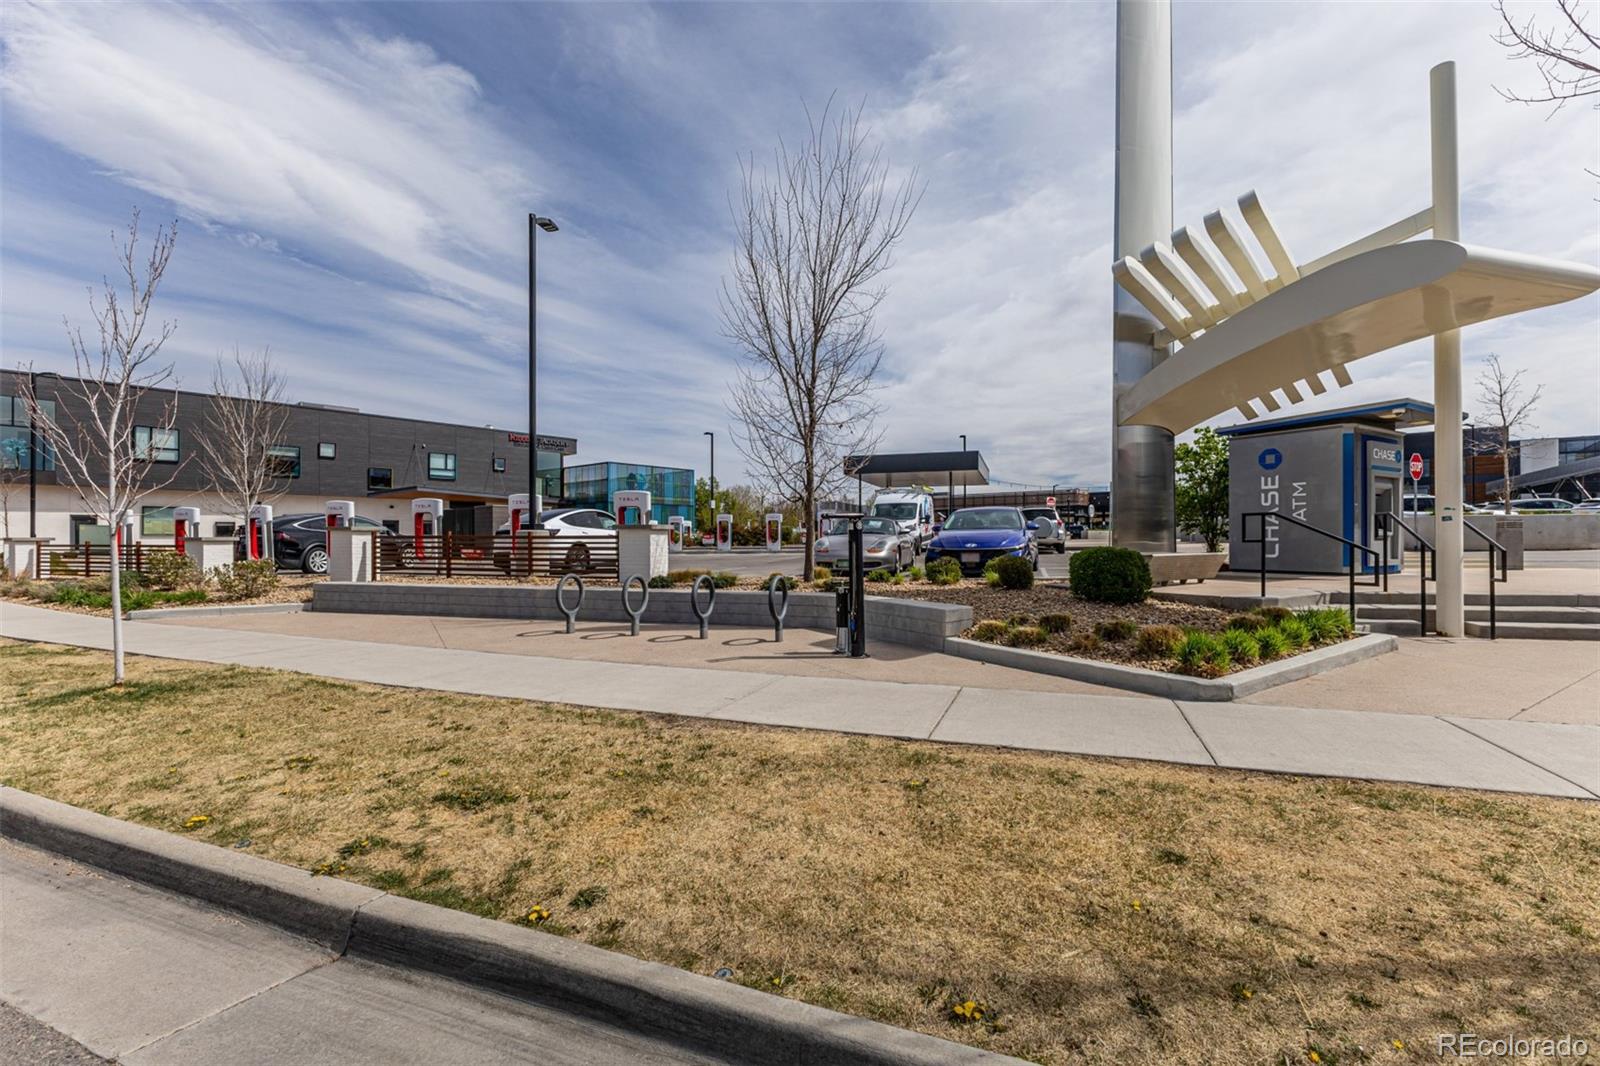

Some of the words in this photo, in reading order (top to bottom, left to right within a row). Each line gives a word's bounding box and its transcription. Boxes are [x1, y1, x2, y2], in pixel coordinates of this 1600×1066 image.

[1373, 447, 1396, 462] CHASE
[1409, 462, 1423, 471] STOP
[1292, 481, 1307, 521] ATM
